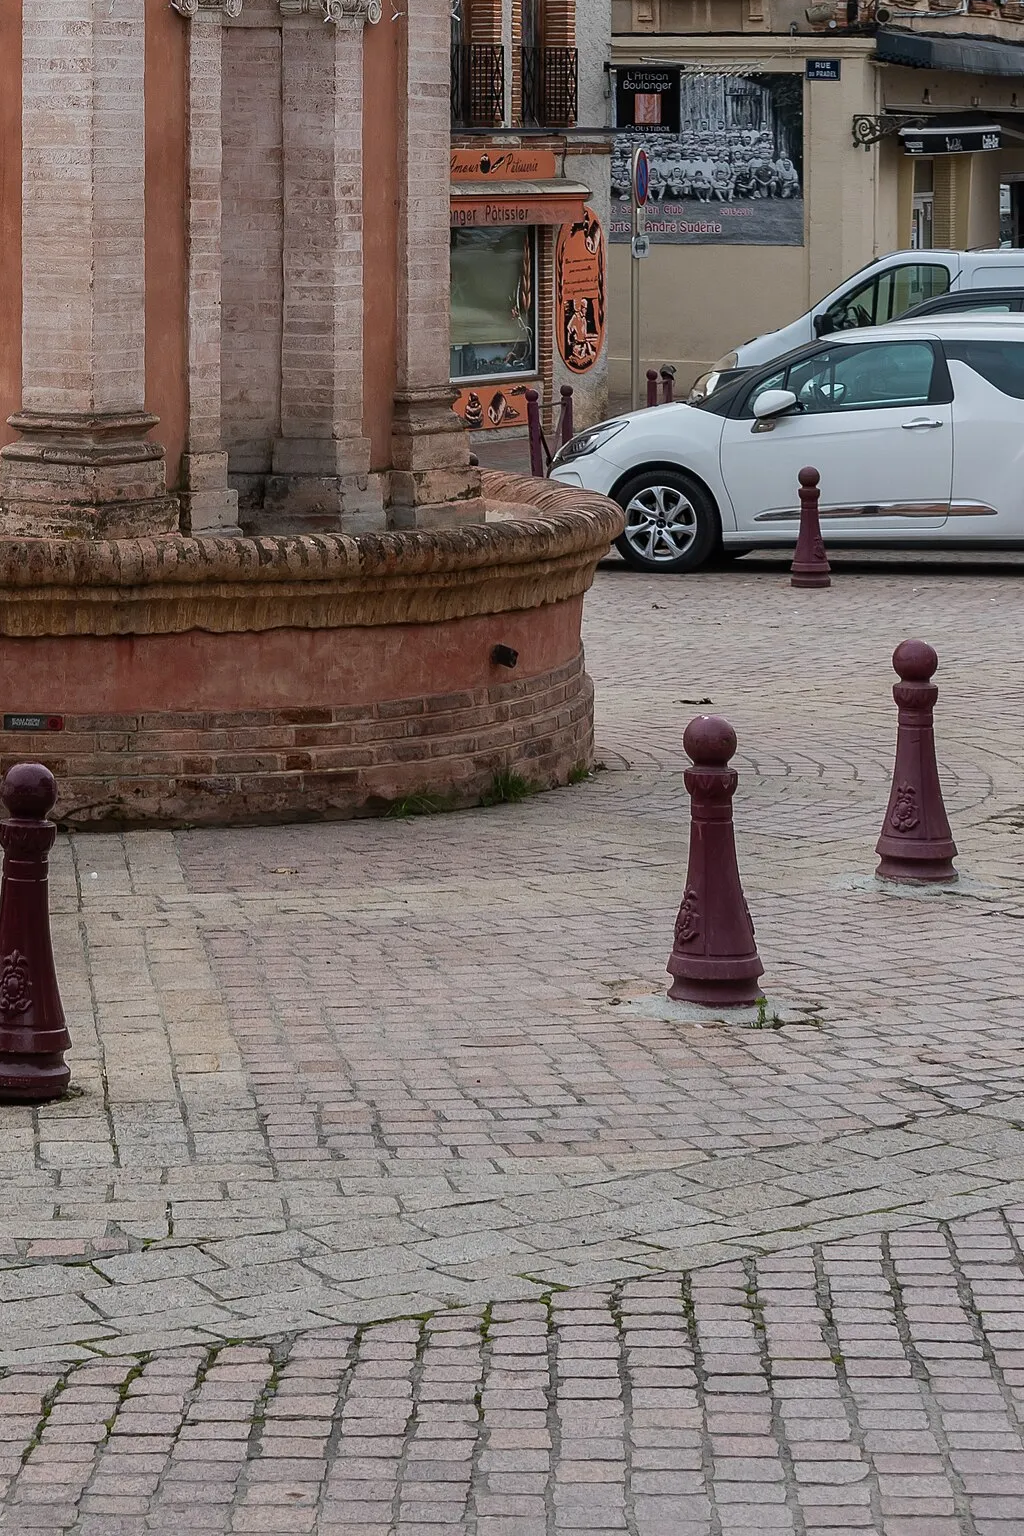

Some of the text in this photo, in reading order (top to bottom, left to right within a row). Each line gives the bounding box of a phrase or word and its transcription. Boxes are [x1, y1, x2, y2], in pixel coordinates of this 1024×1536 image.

[627, 71, 669, 81] L'Artisan
[816, 70, 837, 78] PRADEL
[622, 80, 673, 92] Boulanger
[485, 204, 529, 222] Pâtissier
[663, 204, 683, 214] Club
